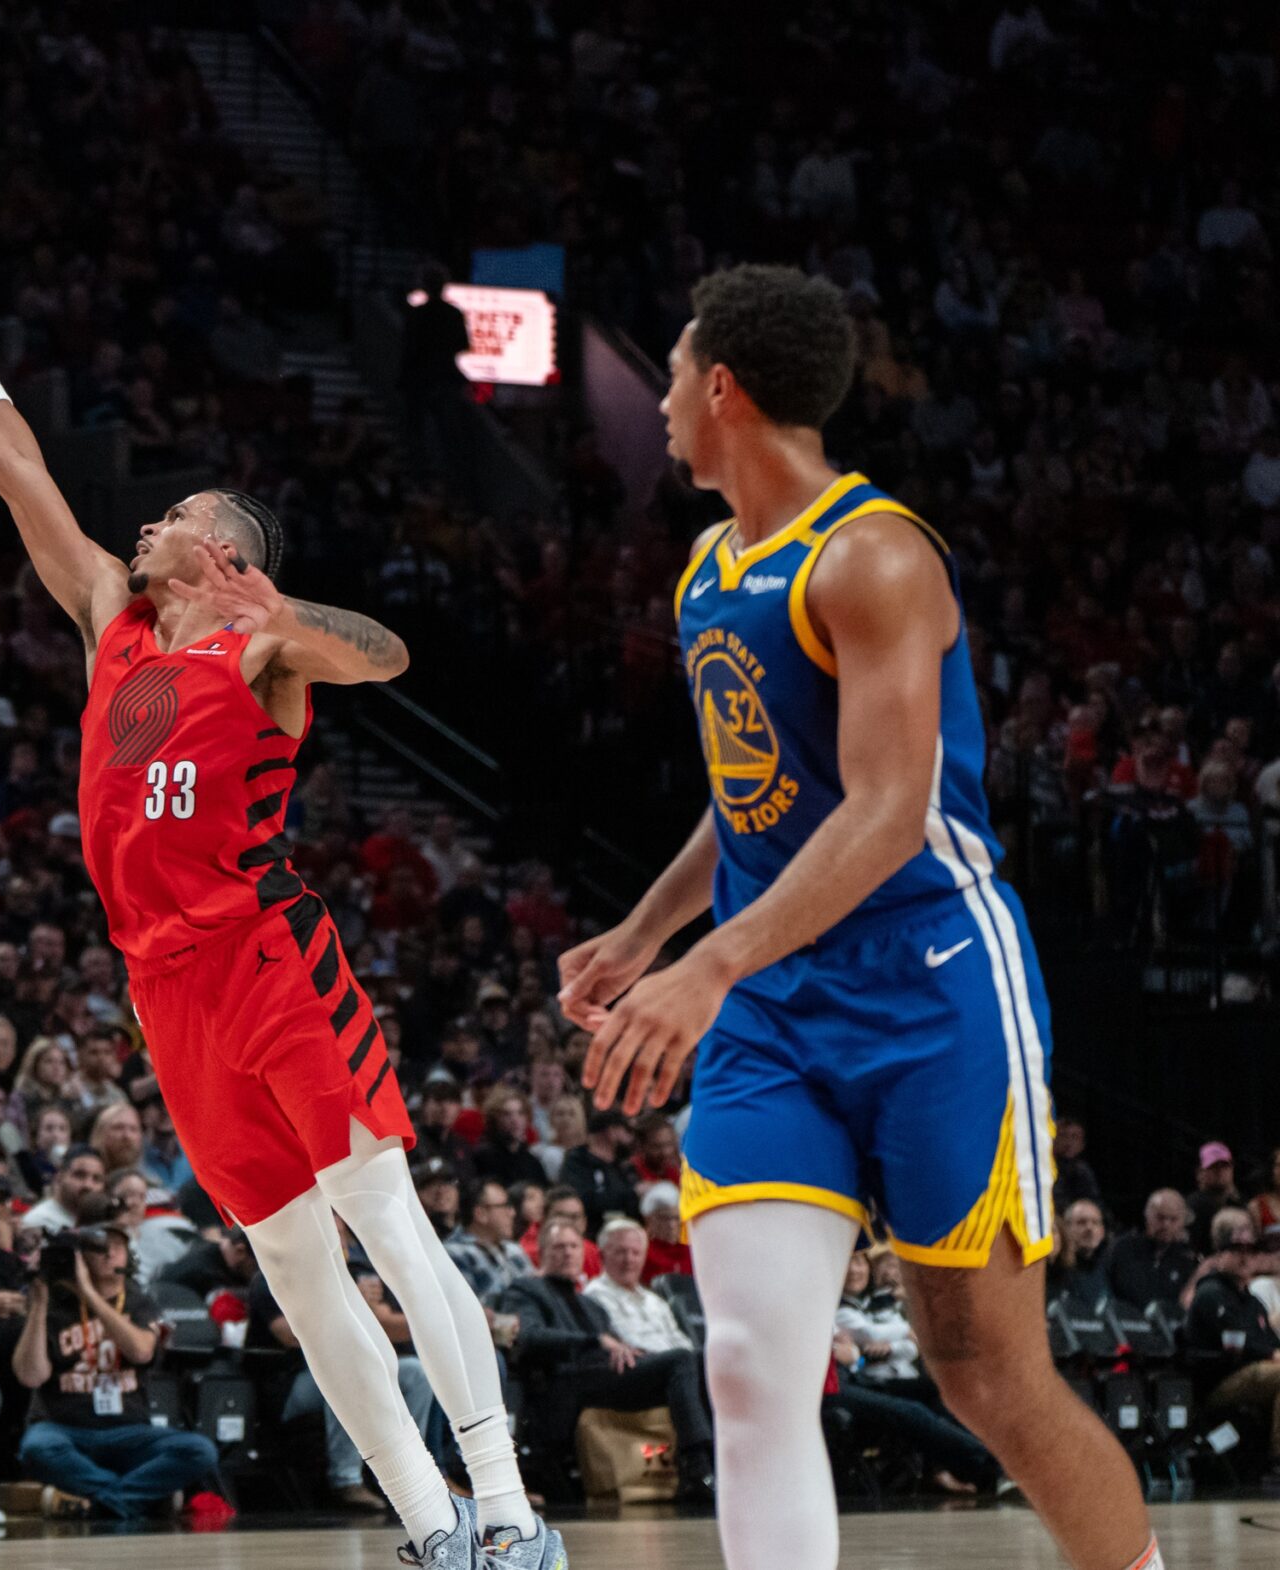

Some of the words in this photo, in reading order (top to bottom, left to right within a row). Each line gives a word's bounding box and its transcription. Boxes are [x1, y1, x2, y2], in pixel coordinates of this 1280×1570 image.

[726, 631, 767, 683] STATE
[724, 689, 764, 734] 32
[144, 760, 197, 820] 33
[720, 774, 800, 834] RIORS
